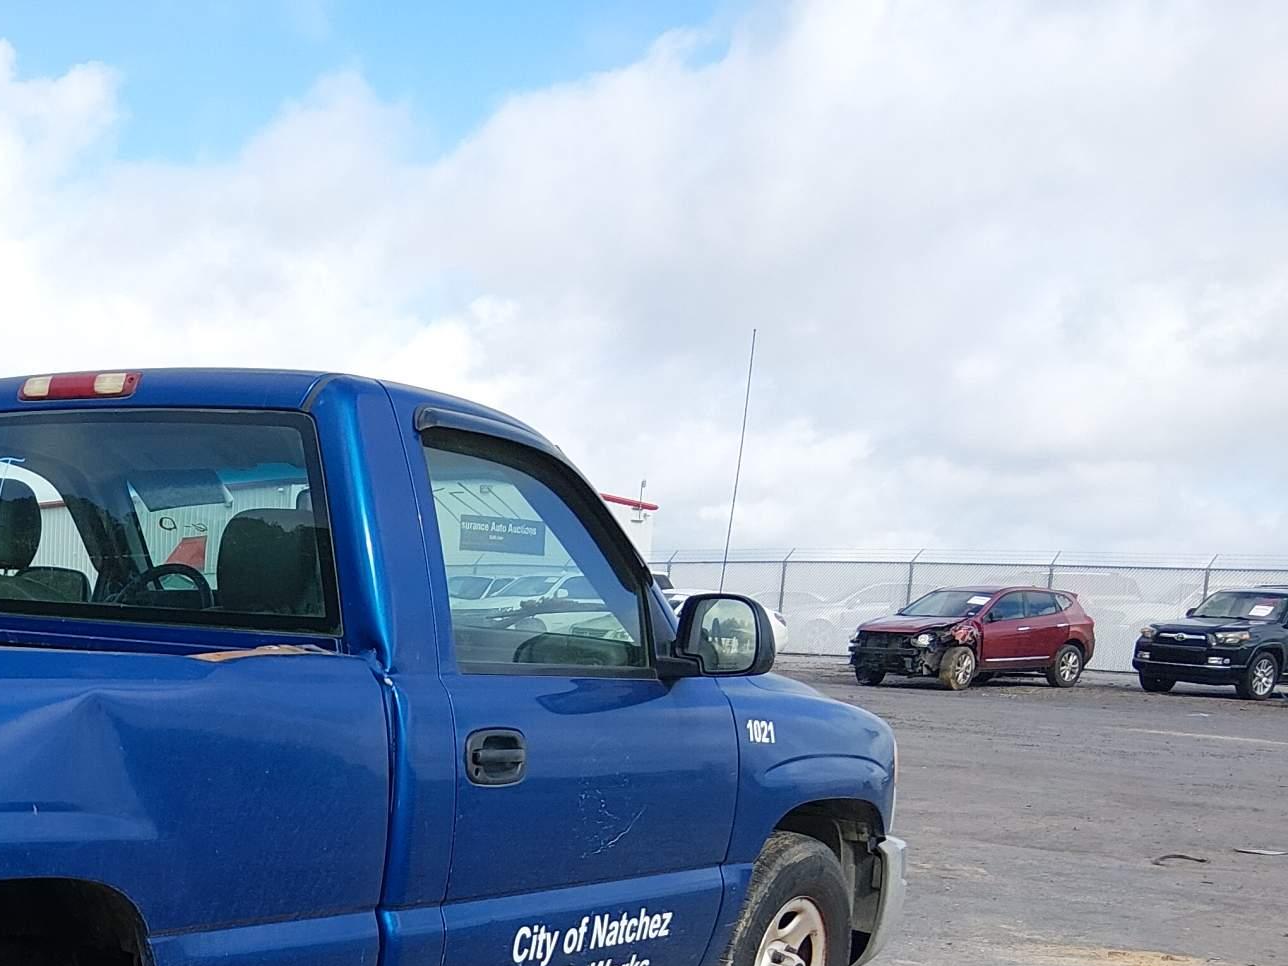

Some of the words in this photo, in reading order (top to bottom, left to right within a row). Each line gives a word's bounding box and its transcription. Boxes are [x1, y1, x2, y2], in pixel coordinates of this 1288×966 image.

[490, 521, 507, 533] Auto
[746, 719, 776, 744] 1021
[512, 924, 560, 966] City
[563, 916, 590, 954] of
[589, 908, 673, 950] Natchez
